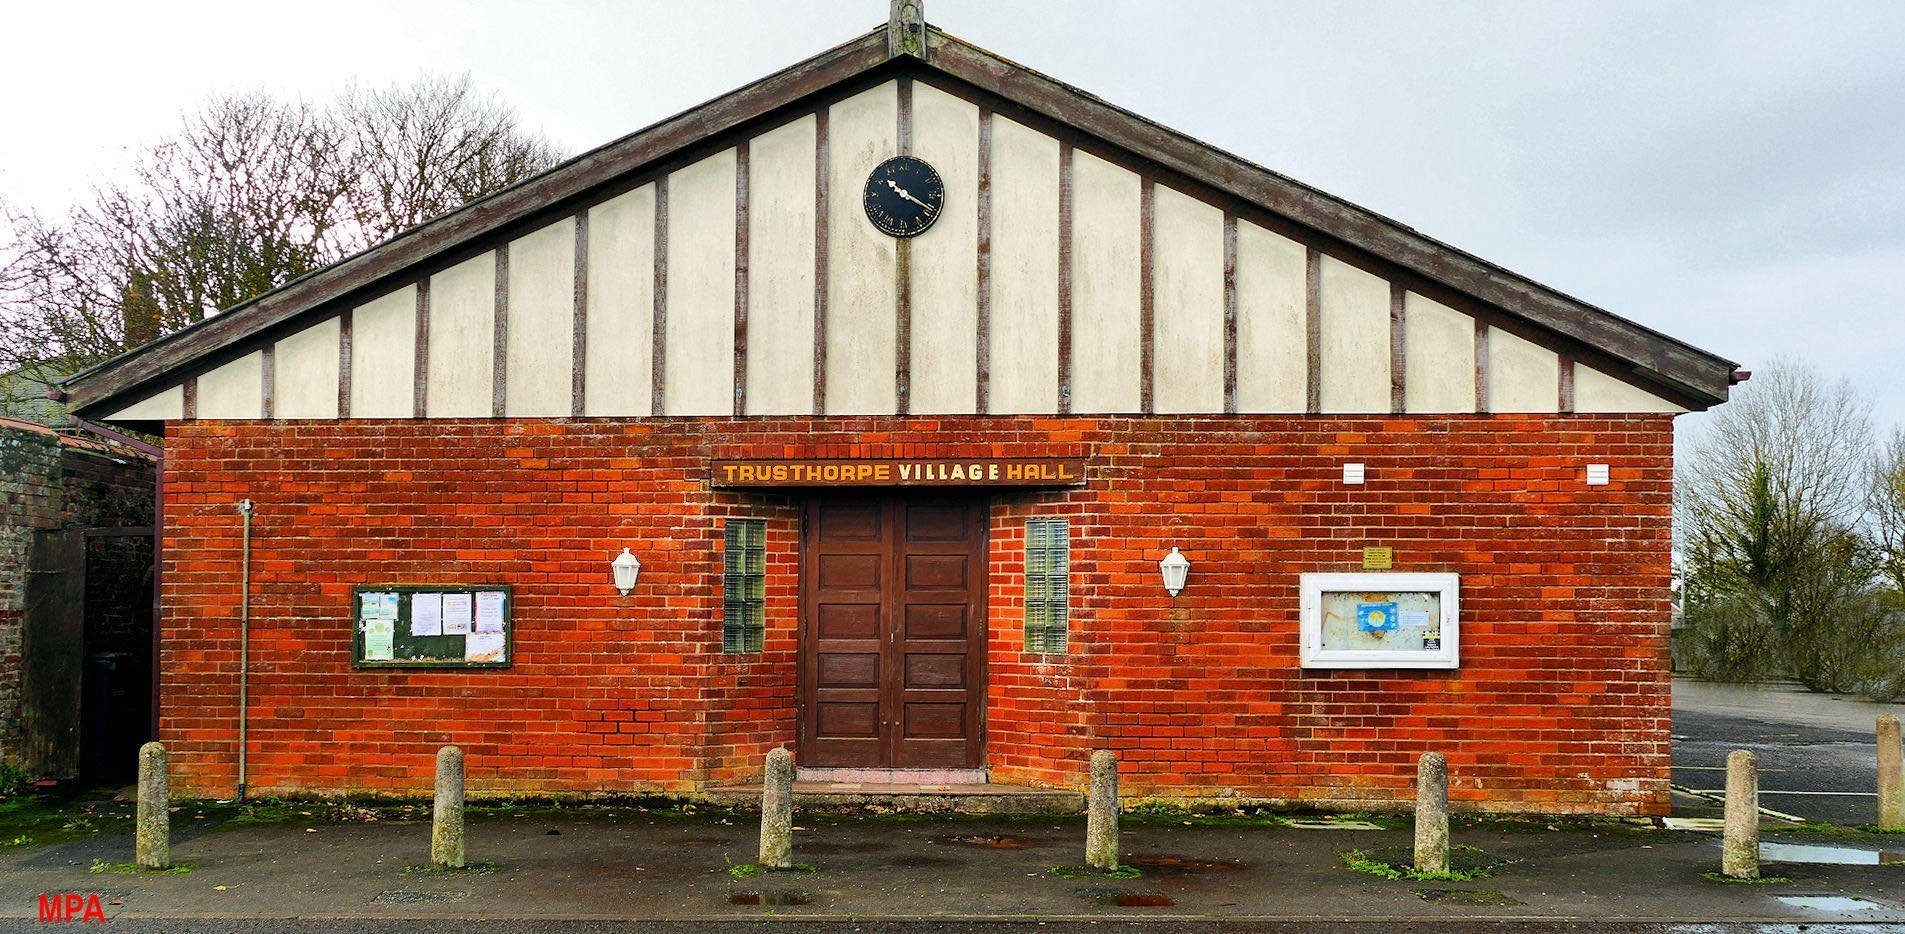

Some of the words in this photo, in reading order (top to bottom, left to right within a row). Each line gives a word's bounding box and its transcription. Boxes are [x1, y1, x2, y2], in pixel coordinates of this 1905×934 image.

[723, 464, 890, 481] TRUSTHORPE
[898, 463, 999, 481] VILLAGE
[1006, 463, 1074, 480] HALL
